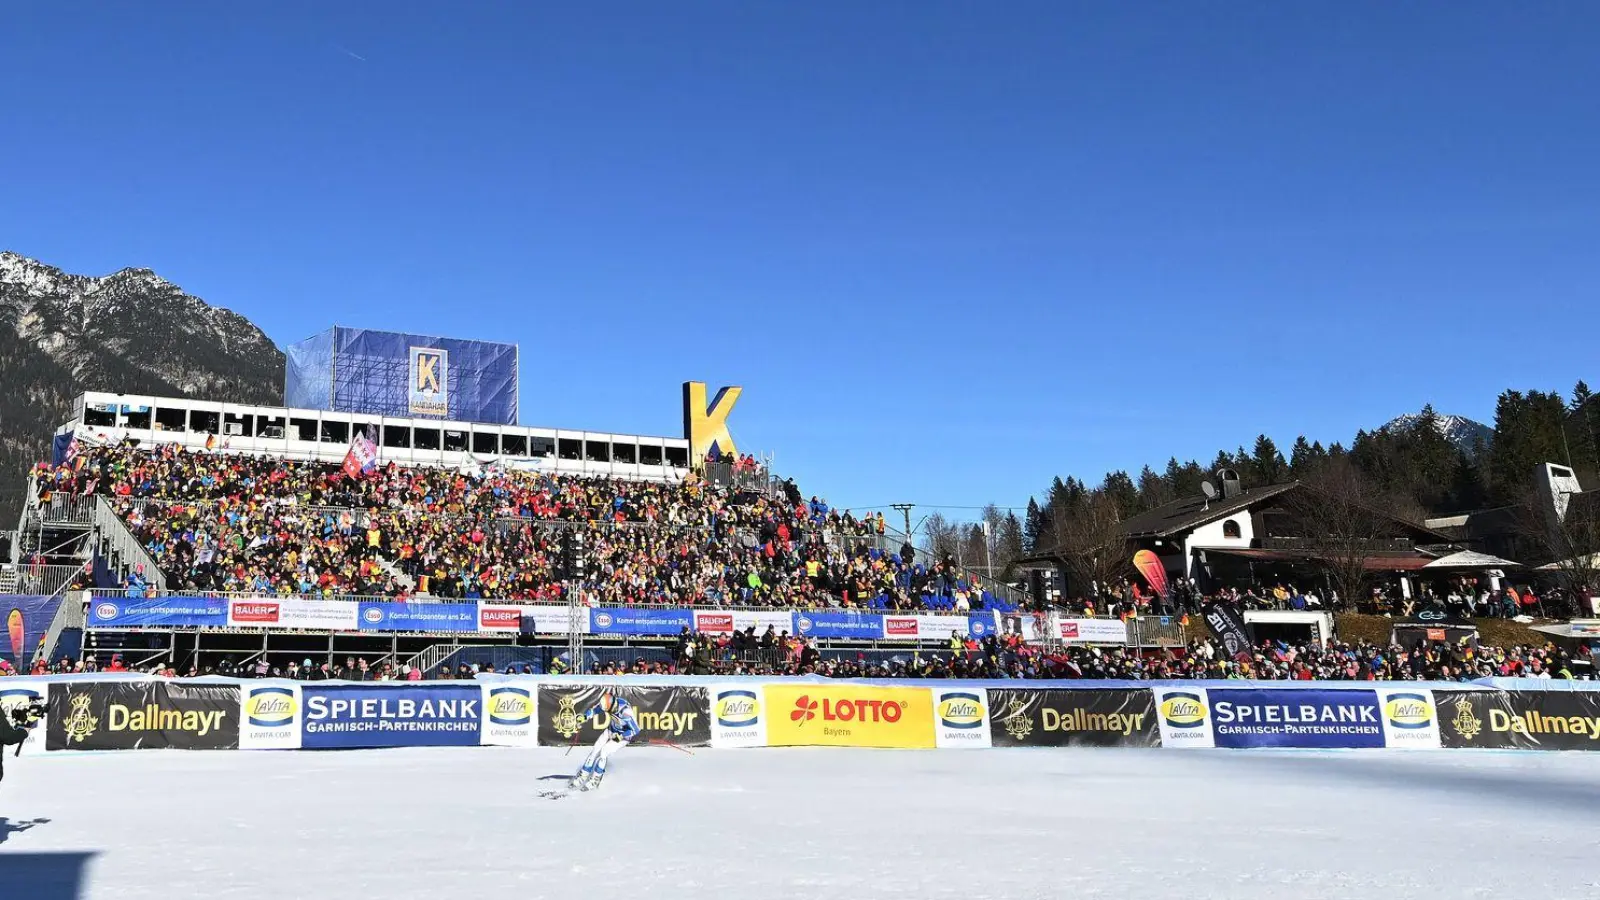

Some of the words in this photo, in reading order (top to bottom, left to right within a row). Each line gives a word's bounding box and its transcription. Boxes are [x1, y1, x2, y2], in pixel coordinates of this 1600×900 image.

[418, 354, 439, 392] K
[684, 381, 743, 469] K
[100, 605, 115, 615] Esso
[235, 606, 268, 614] BAUER
[367, 611, 381, 619] Esso
[389, 612, 409, 620] Komm
[410, 613, 448, 621] entspannter
[483, 612, 511, 620] BAUER
[700, 617, 723, 625] BAUER
[888, 621, 910, 629] BAUER
[307, 696, 478, 719] SPIELBANK
[1216, 702, 1377, 722] SPIELBANK
[109, 704, 226, 736] Dallmayr
[592, 705, 697, 736] Dlmayr
[1042, 708, 1144, 736] Dallmayr
[306, 720, 477, 733] GARMISCH-PARTENKIRCHEN
[824, 727, 851, 736] Bayern
[1218, 724, 1379, 735] GARMISCH-PARTENKIRCHEN
